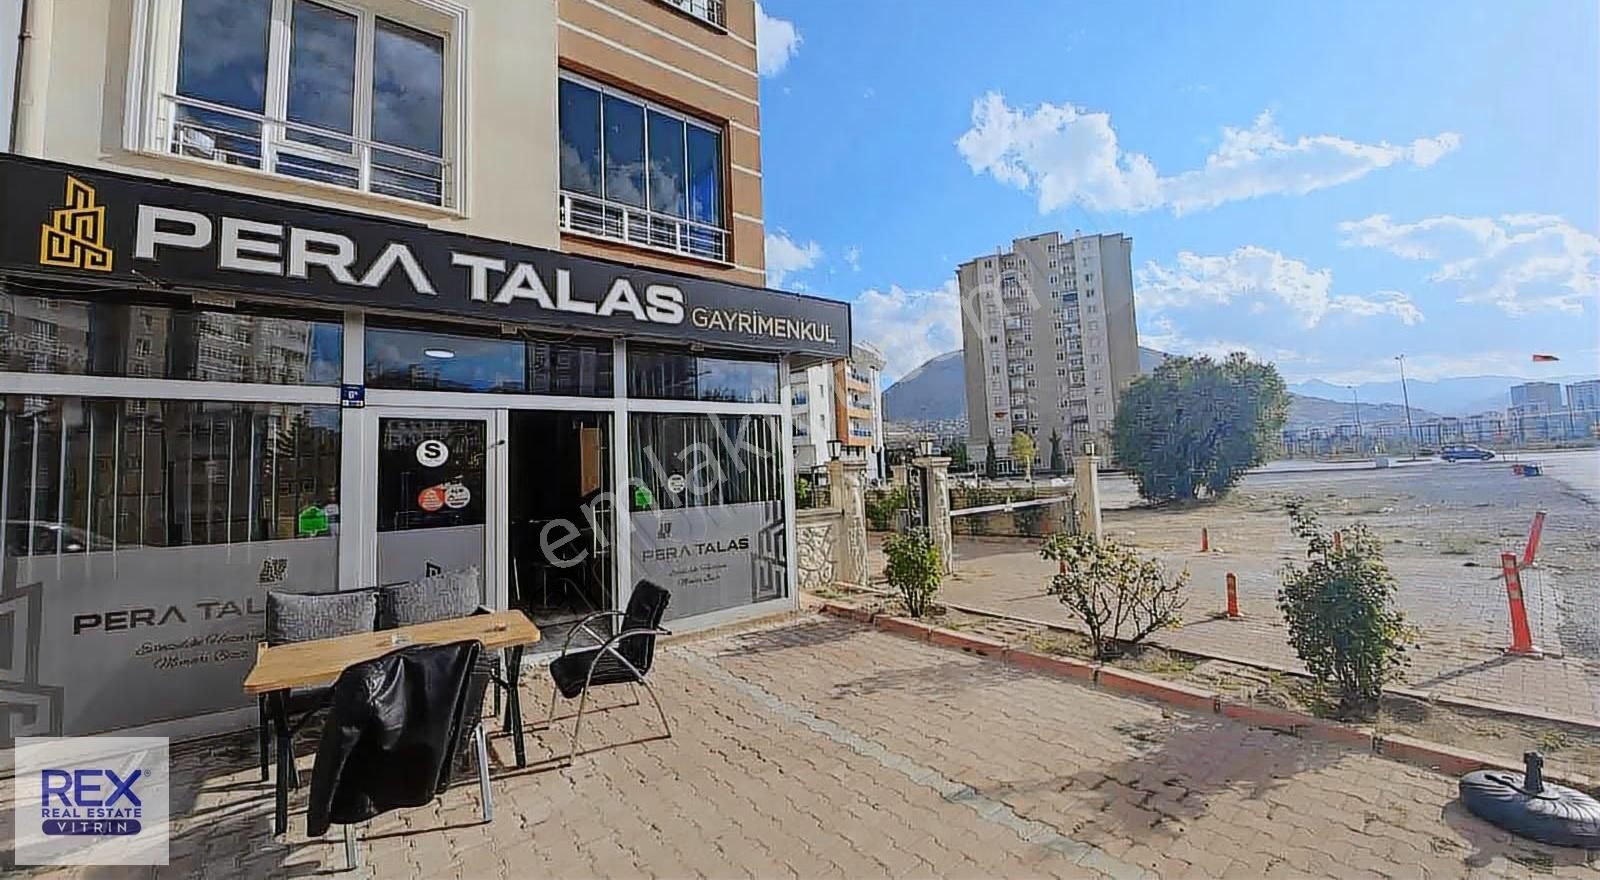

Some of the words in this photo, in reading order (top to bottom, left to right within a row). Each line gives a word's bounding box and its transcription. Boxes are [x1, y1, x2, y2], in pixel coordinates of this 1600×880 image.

[451, 252, 685, 324] TALAS
[692, 308, 836, 344] GAYRİMENKUL
[424, 443, 441, 458] S
[694, 538, 750, 555] TALAS
[197, 598, 266, 620] TAL
